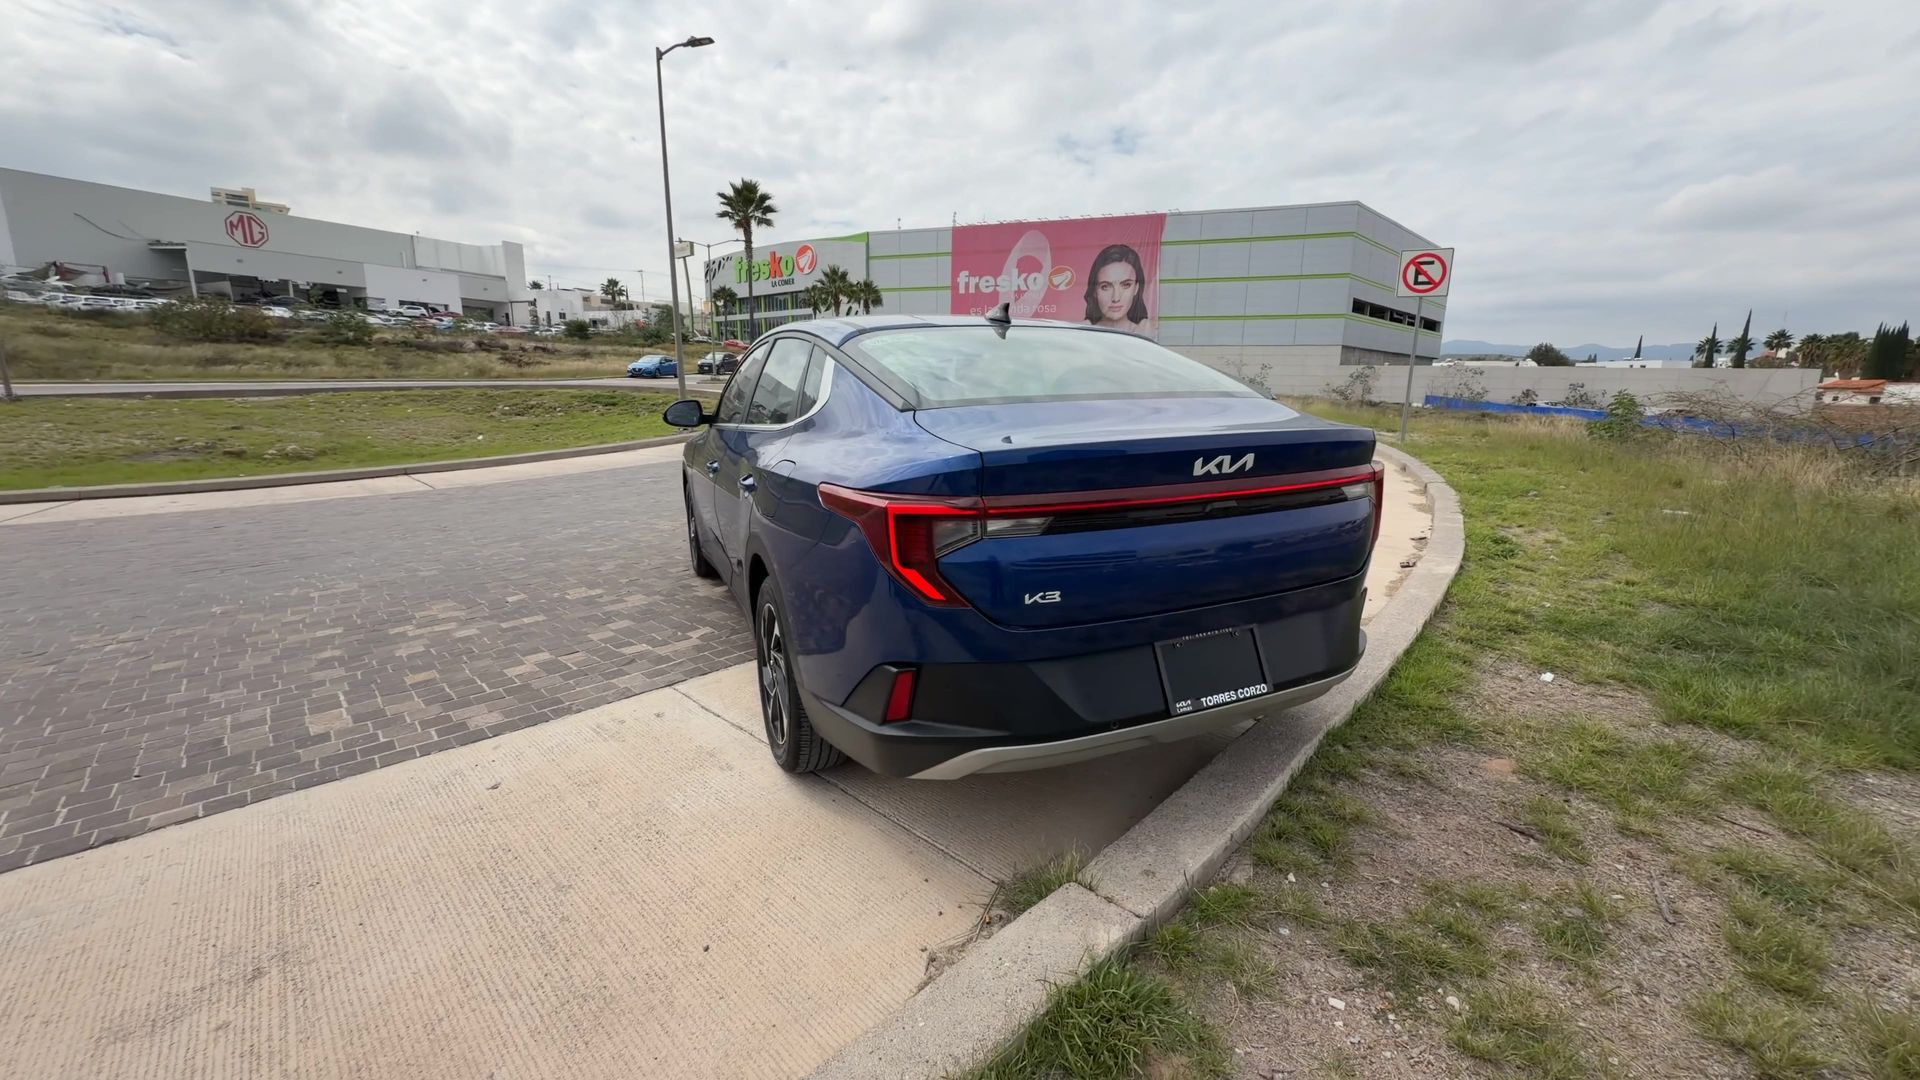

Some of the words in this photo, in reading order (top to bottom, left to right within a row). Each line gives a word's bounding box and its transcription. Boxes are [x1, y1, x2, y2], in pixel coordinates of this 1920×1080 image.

[227, 213, 266, 246] MG
[957, 268, 1044, 294] fresko
[1193, 453, 1255, 476] KIA
[1024, 590, 1061, 605] K3
[1200, 691, 1237, 707] TORRES
[1237, 683, 1268, 699] CORZO
